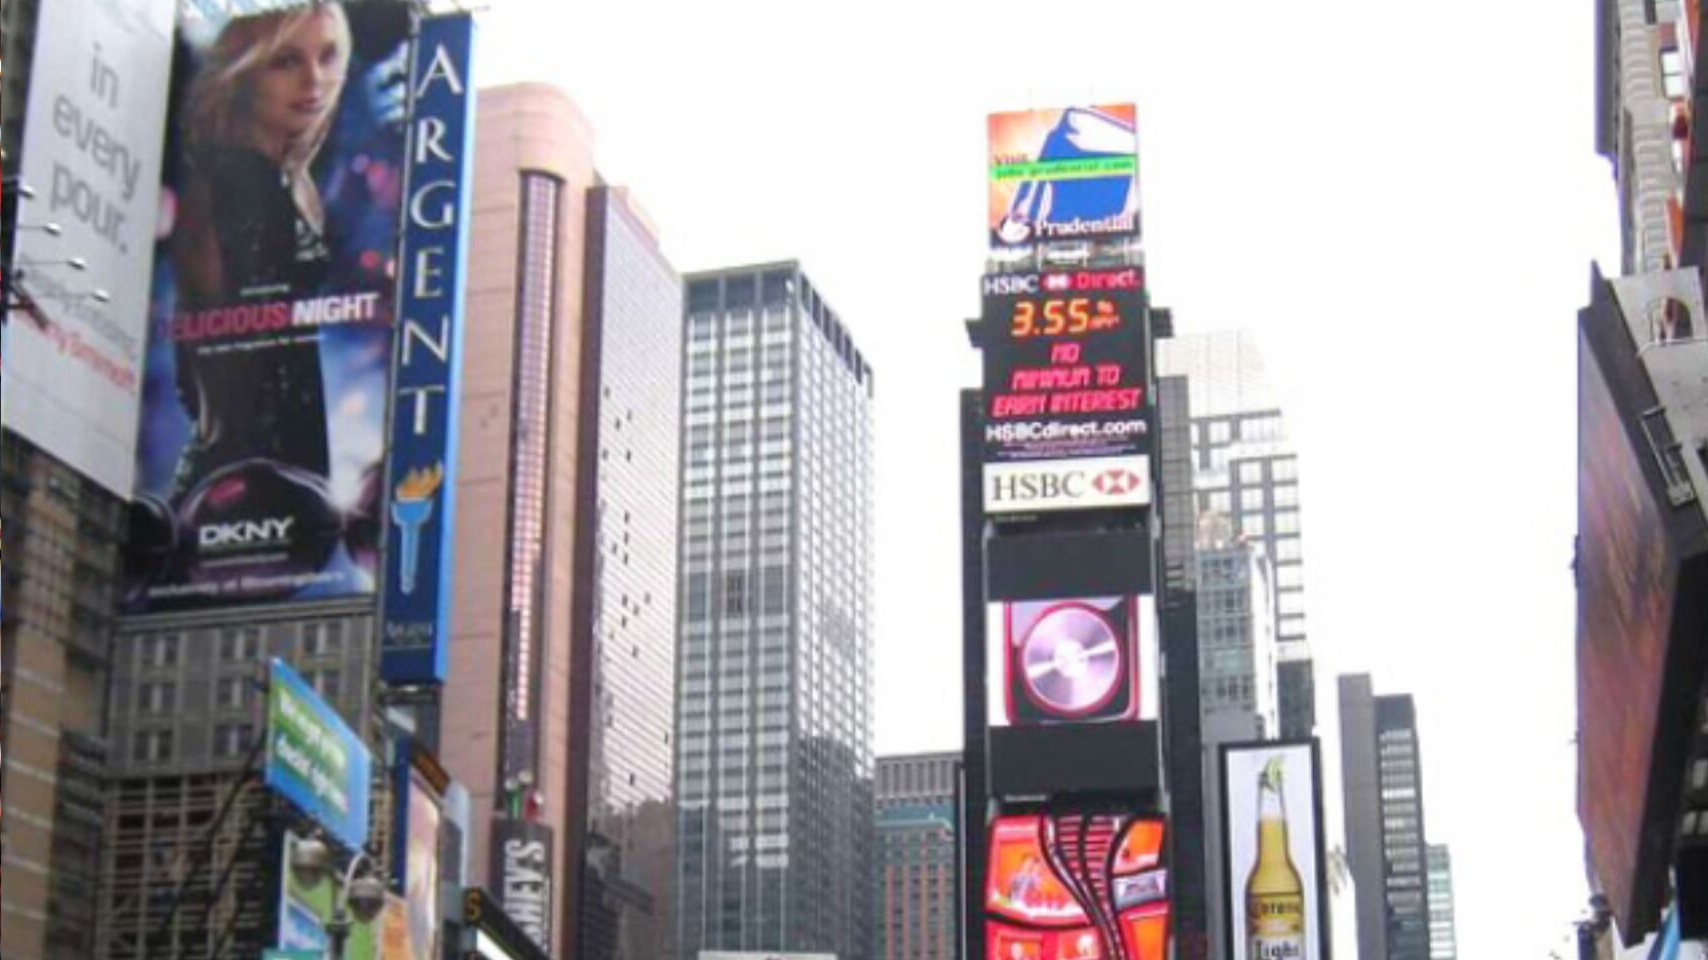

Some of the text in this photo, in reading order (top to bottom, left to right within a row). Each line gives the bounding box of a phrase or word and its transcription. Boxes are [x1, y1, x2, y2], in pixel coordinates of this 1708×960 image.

[90, 41, 120, 109] in
[52, 94, 142, 203] every
[398, 43, 463, 435] ARGENT
[1036, 213, 1134, 238] Prudential
[984, 274, 1039, 296] HSBC
[291, 291, 380, 327] NIGHT
[985, 418, 1148, 443] HSBCdirect.com
[994, 471, 1085, 501] HSBC
[199, 516, 295, 546] DKNY
